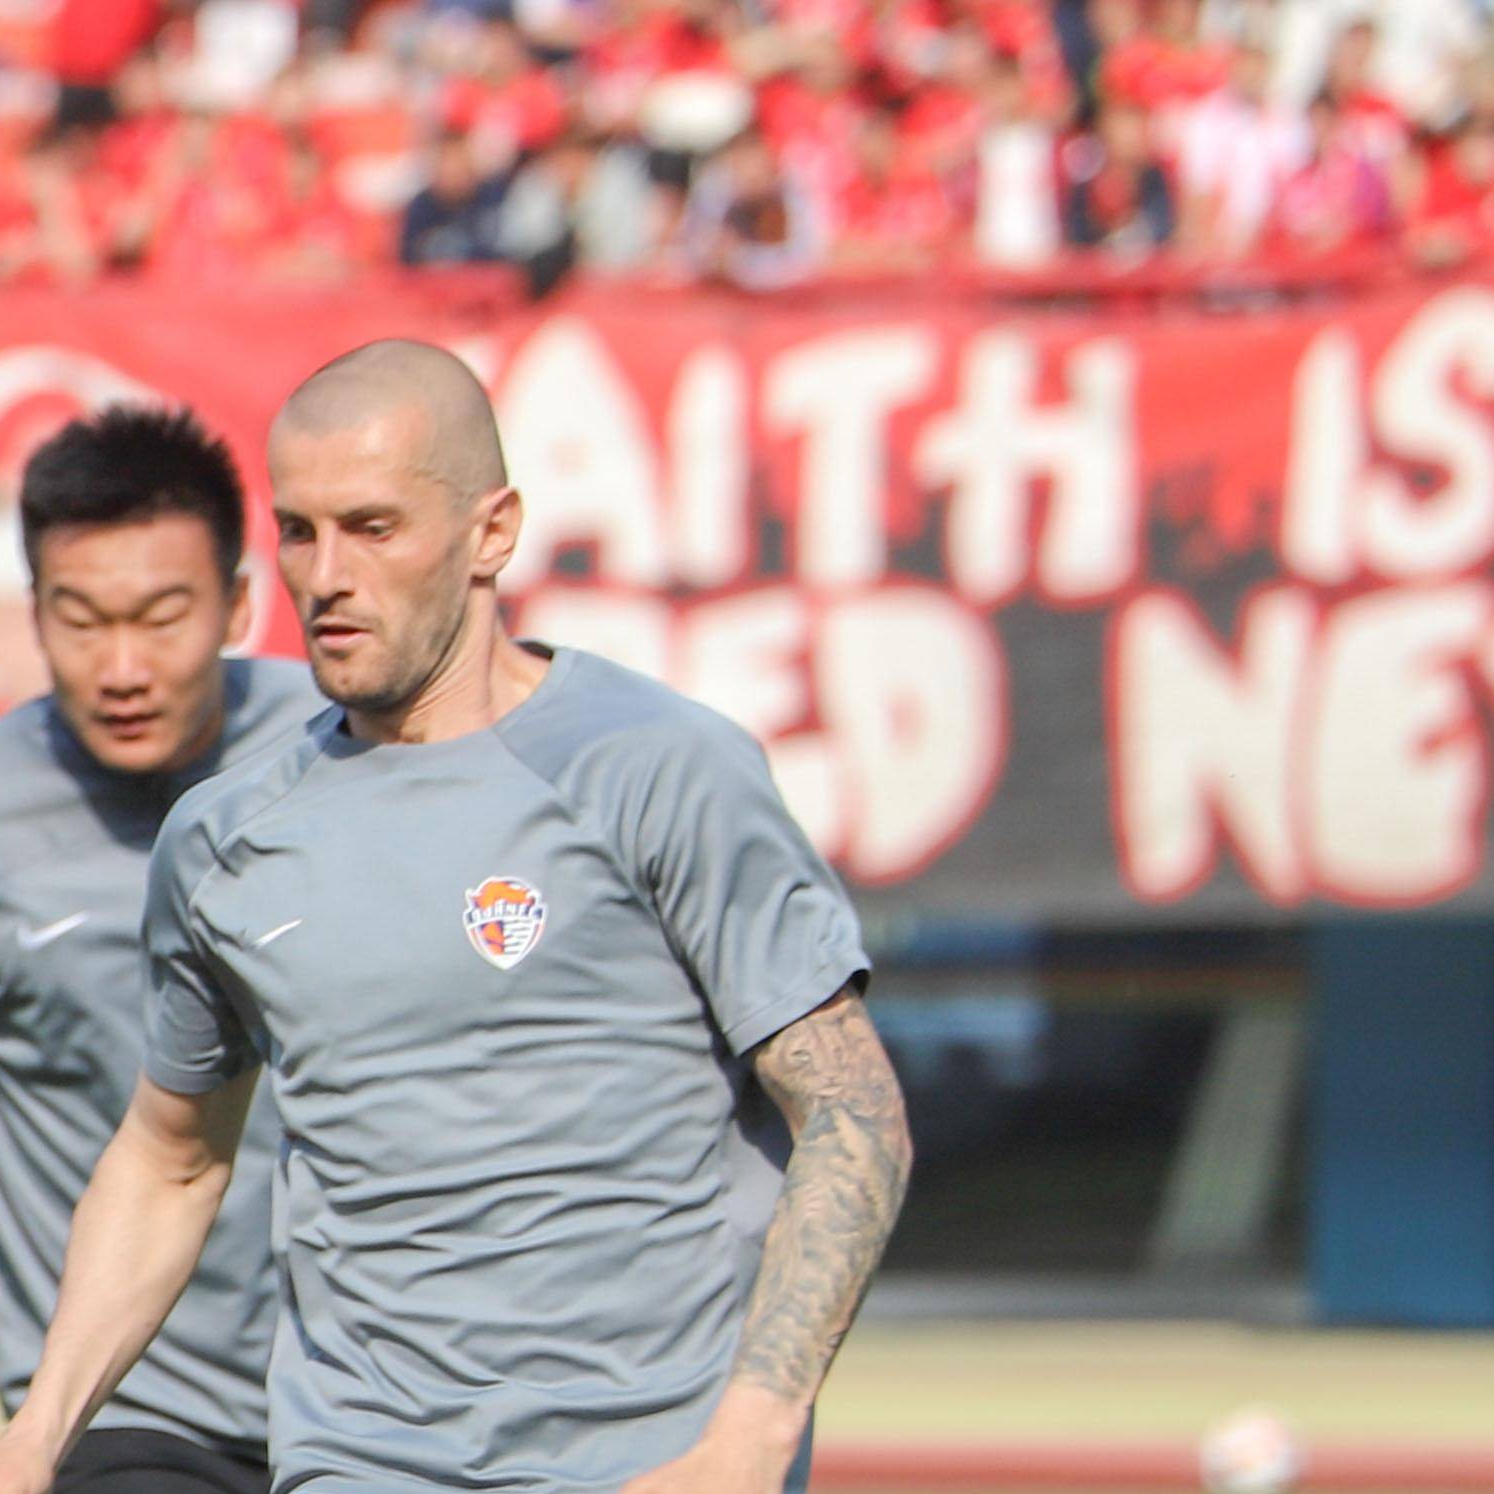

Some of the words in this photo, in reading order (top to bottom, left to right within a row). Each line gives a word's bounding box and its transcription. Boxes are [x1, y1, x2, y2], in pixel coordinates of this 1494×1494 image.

[452, 312, 1143, 602] AITH
[1280, 286, 1494, 584] IS
[1114, 588, 1494, 903] NE
